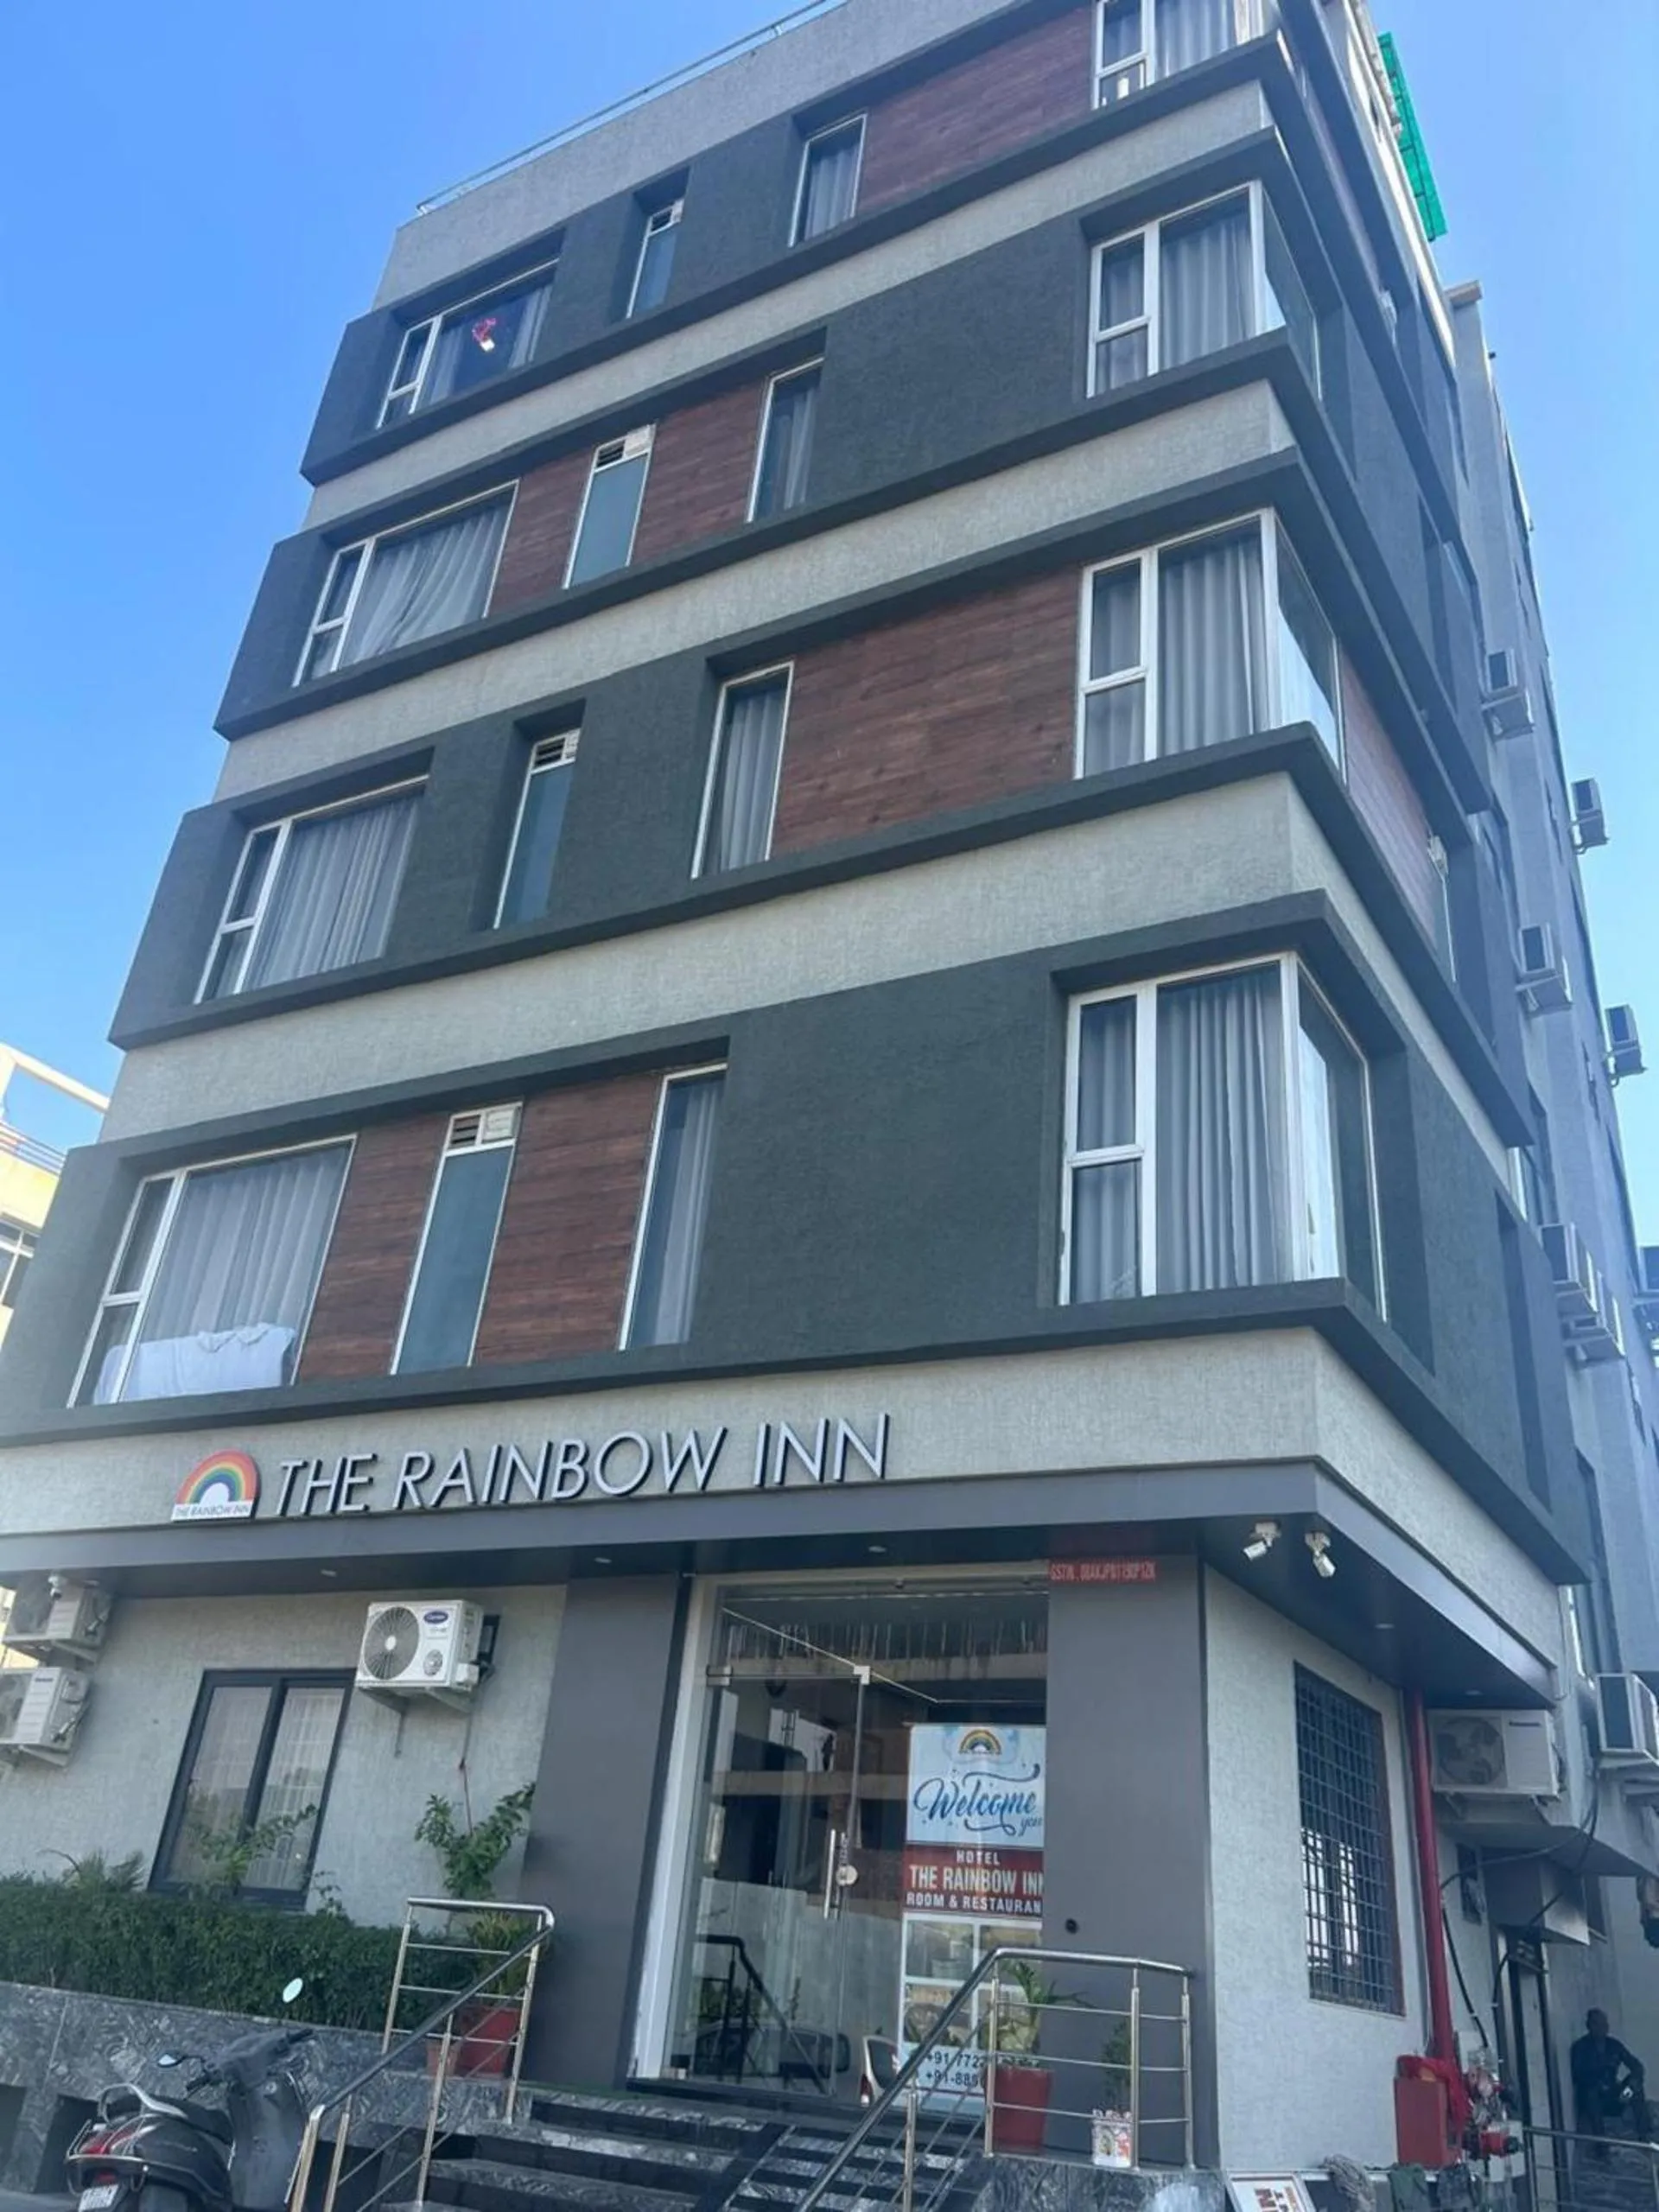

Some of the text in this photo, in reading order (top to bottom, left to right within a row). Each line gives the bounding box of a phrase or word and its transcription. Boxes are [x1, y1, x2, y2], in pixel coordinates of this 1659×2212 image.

[276, 1413, 890, 1516] THE RAINBOW INN
[913, 1764, 1039, 1834] Welcome
[956, 1850, 1001, 1866] HOTEL
[909, 1865, 938, 1889] THE
[943, 1866, 1017, 1894] RAINBOW
[906, 1891, 944, 1908] ROOM
[949, 1895, 958, 1909] &
